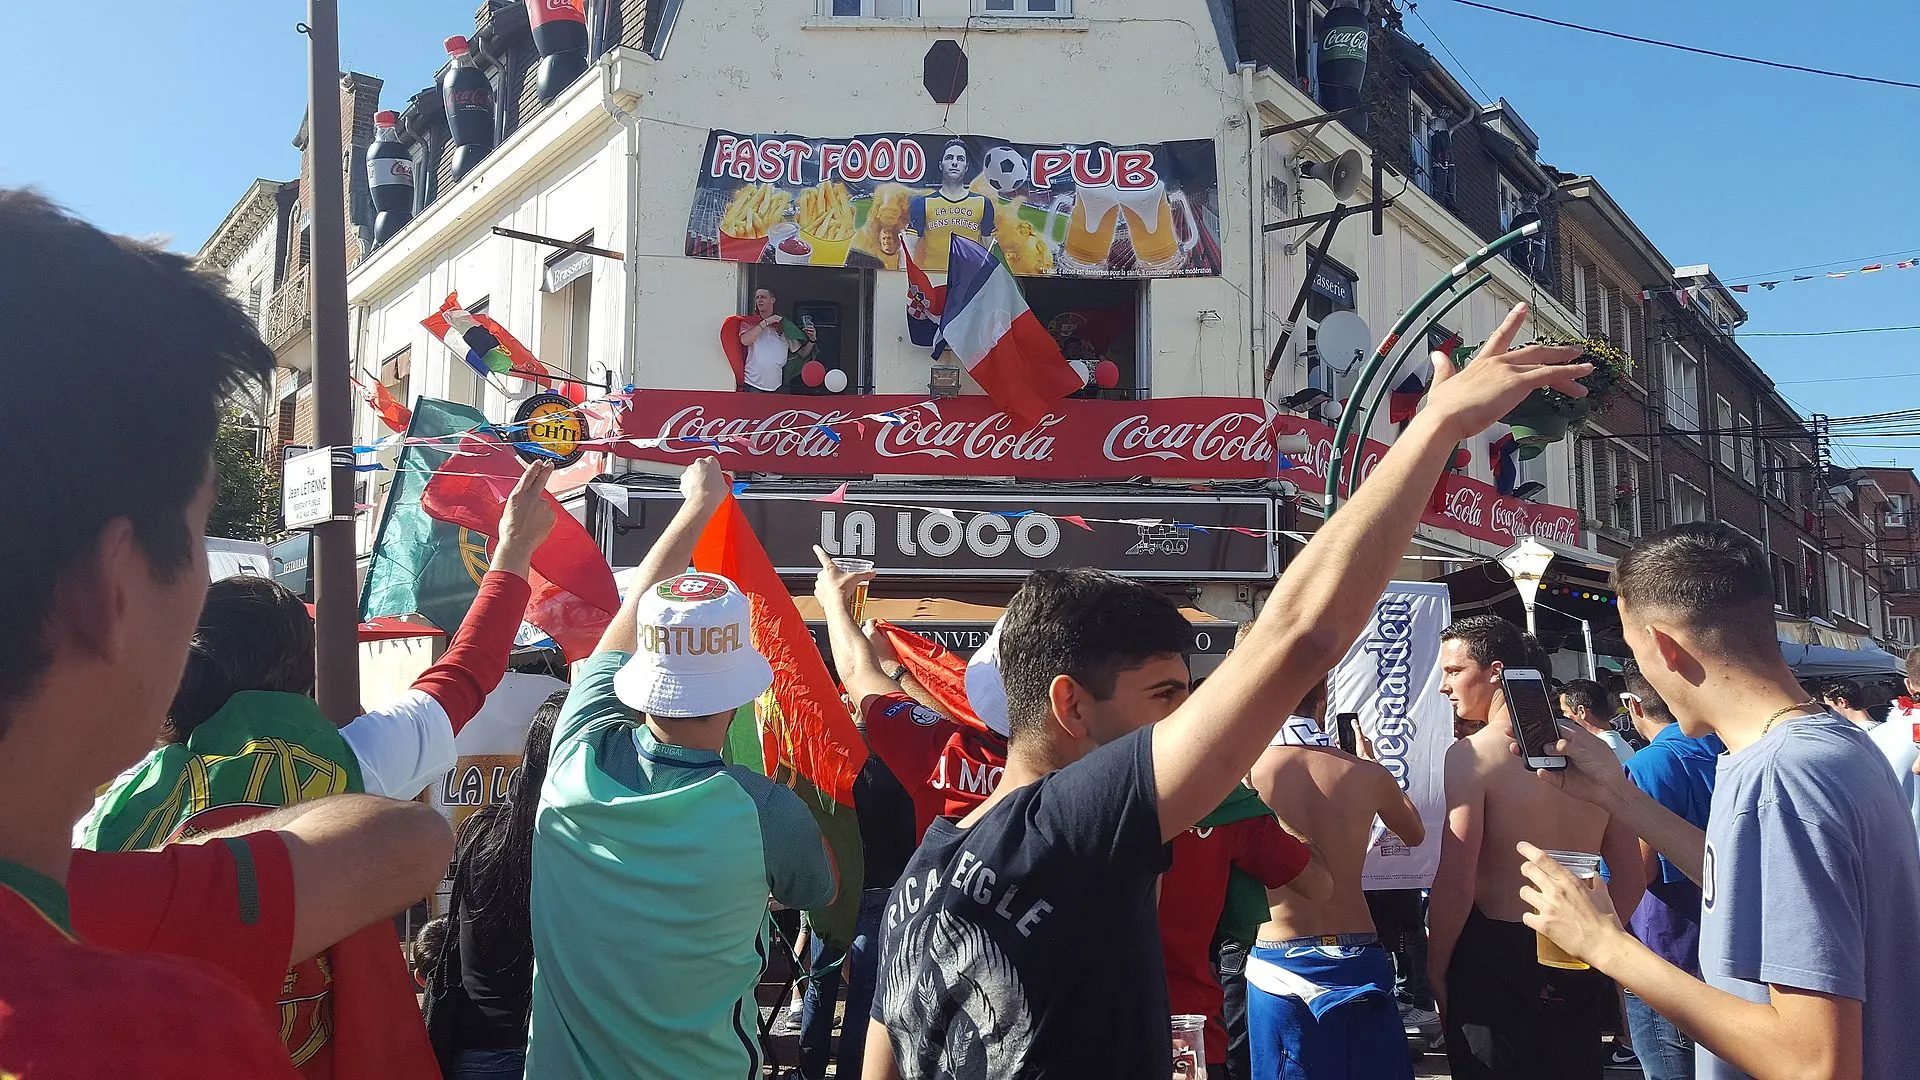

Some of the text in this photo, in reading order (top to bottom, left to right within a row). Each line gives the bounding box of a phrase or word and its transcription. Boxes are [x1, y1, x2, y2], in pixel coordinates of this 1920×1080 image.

[1323, 29, 1368, 52] Coca-Col
[711, 135, 926, 184] FAST FOOD
[1031, 147, 1159, 191] PUB
[554, 253, 591, 286] Brasserie
[1308, 264, 1345, 298] asserie
[657, 406, 853, 457] Coca-Cola
[875, 412, 1067, 461] Coca-Cola
[1103, 412, 1272, 461] Coca-Cola
[821, 511, 1061, 558] LA LOCO
[1365, 600, 1417, 793] oegaarden
[441, 765, 484, 806] LA
